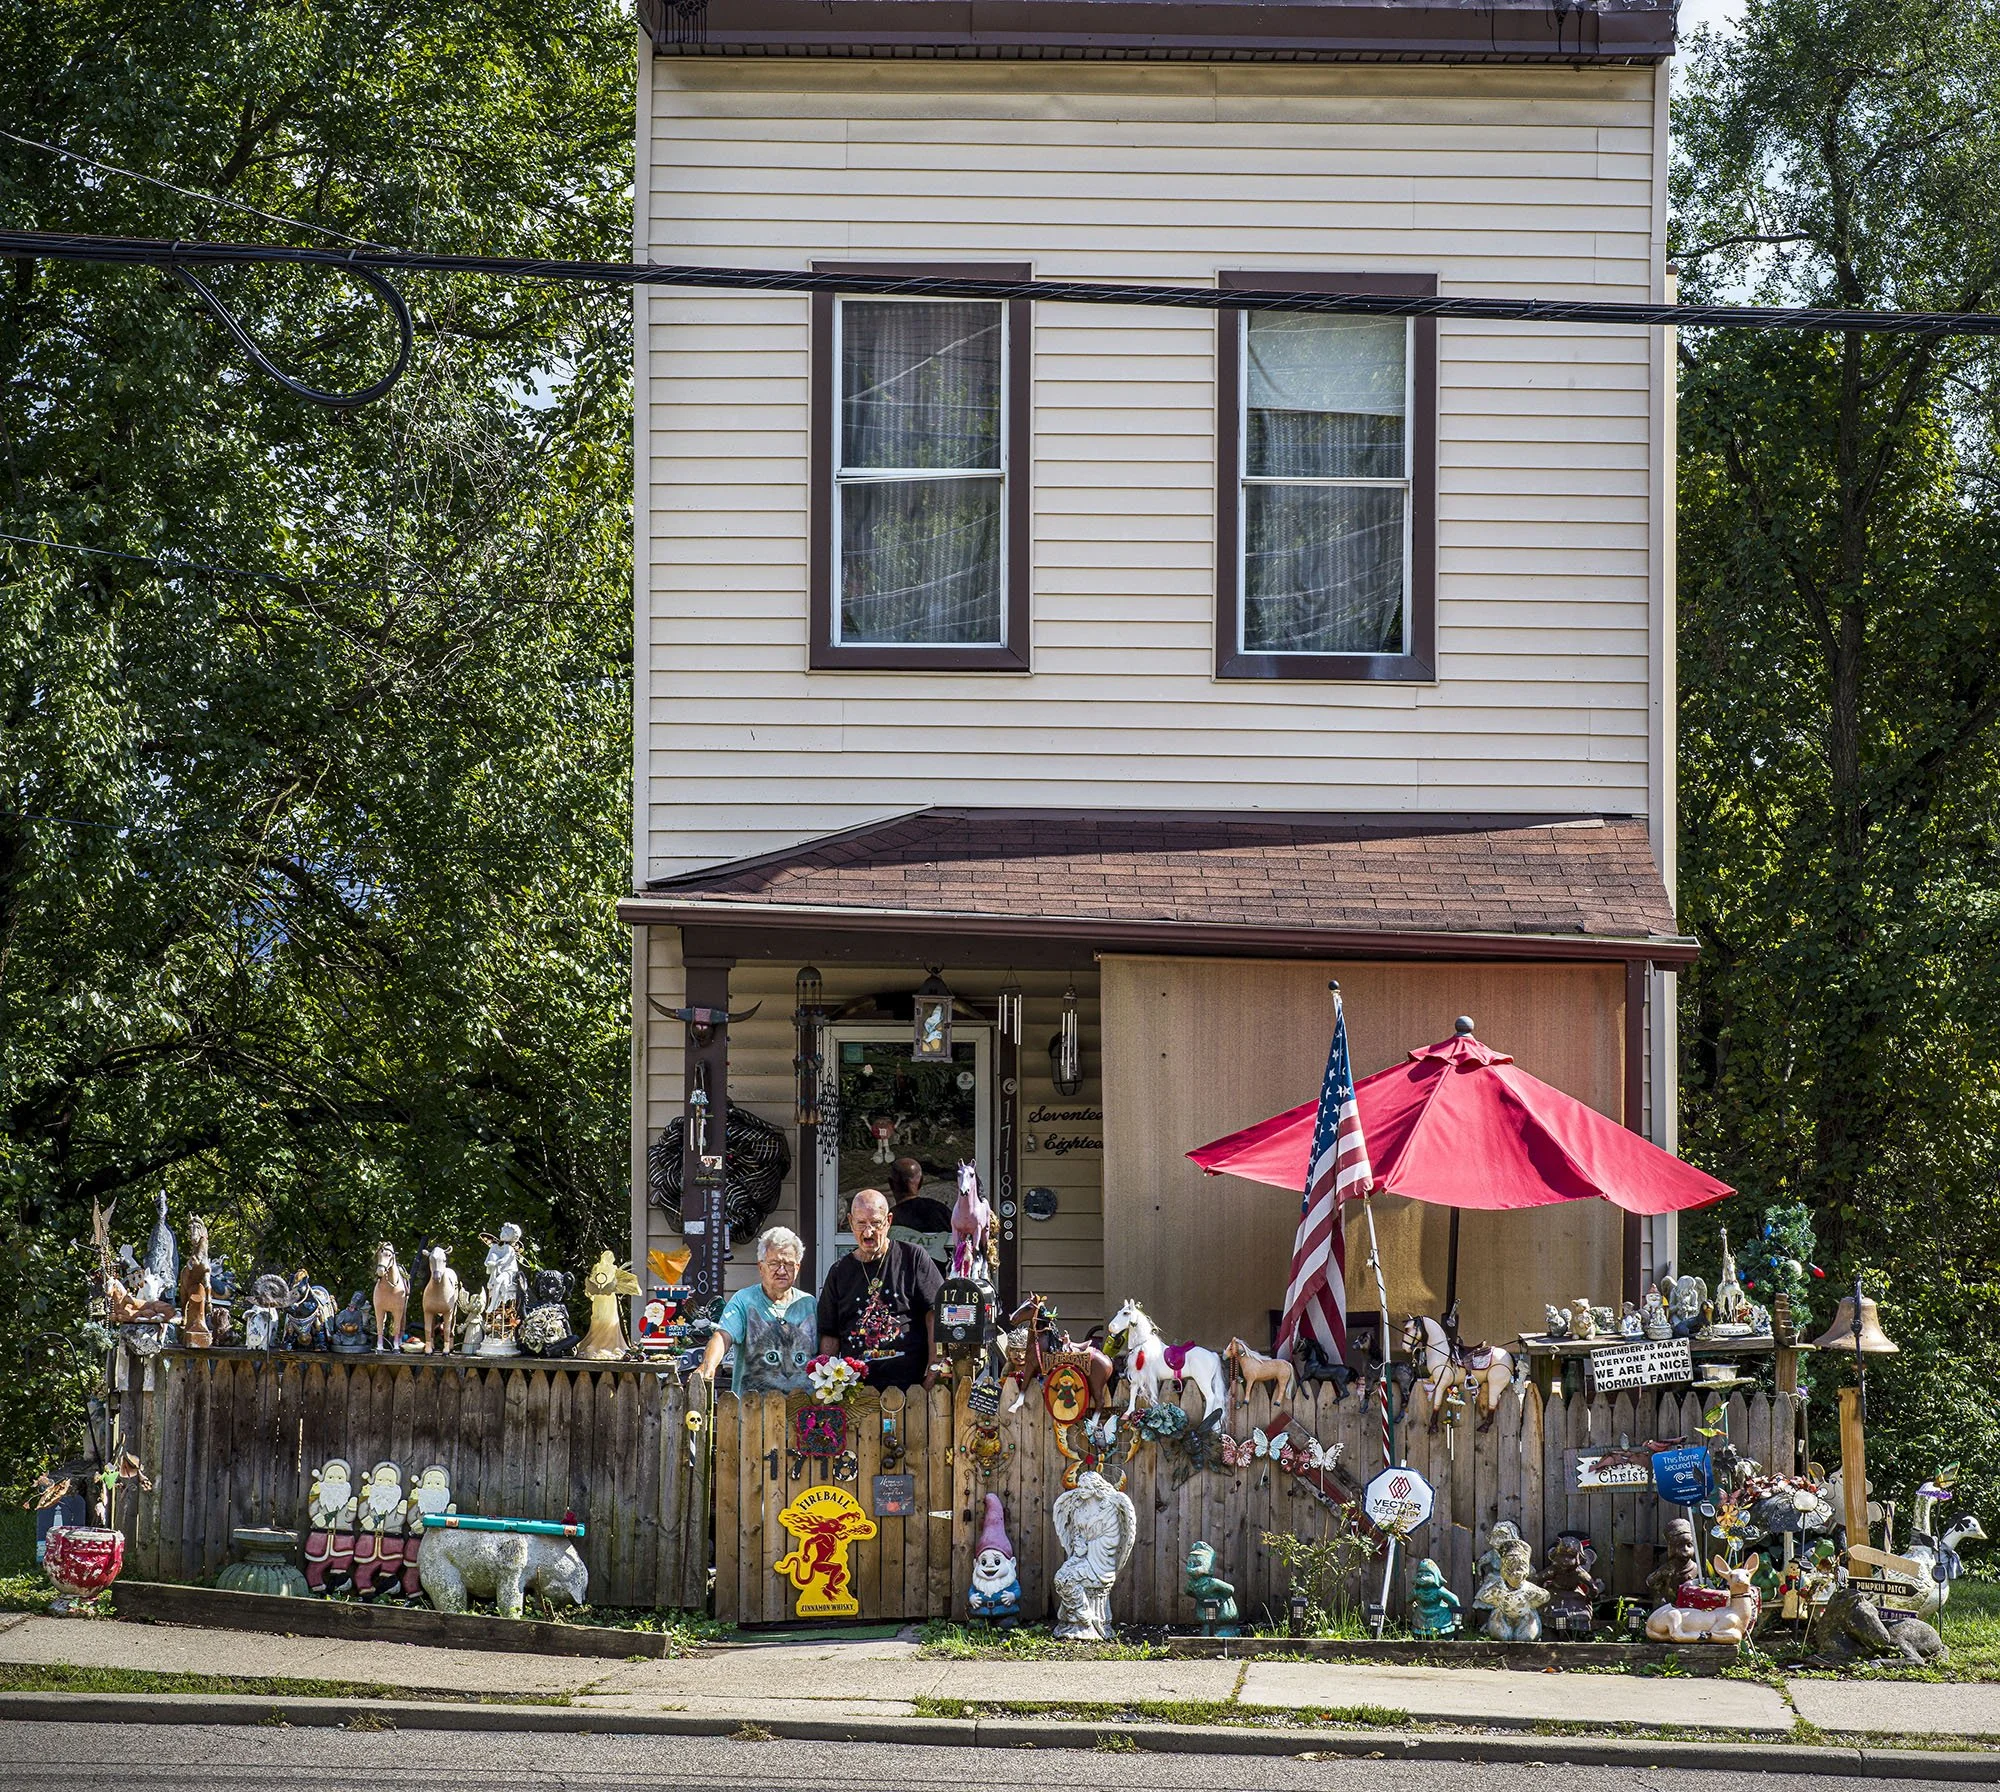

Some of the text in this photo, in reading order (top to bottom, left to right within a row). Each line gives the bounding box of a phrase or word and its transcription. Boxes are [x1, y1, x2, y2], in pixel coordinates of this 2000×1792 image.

[1028, 1105, 1103, 1123] Seventee
[1044, 1133, 1103, 1156] Eightee
[1592, 1345, 1641, 1359] REMEMBER
[1644, 1343, 1655, 1351] AS
[1657, 1341, 1674, 1350] FAR
[1593, 1349, 1689, 1368] EVERYONE KNOWS,
[1595, 1359, 1690, 1379] WE ARE A NICE
[1597, 1370, 1691, 1391] NORMAL FAMILY
[763, 1448, 858, 1482] 1718
[1662, 1453, 1700, 1464] This home
[1664, 1461, 1691, 1472] secured
[799, 1490, 849, 1511] FIREBALL
[1374, 1498, 1421, 1511] VECTOR
[1372, 1506, 1420, 1517] SECUY
[1856, 1581, 1907, 1595] PUMPKIN PATCH
[801, 1603, 853, 1612] CINNAMON WHISKY
